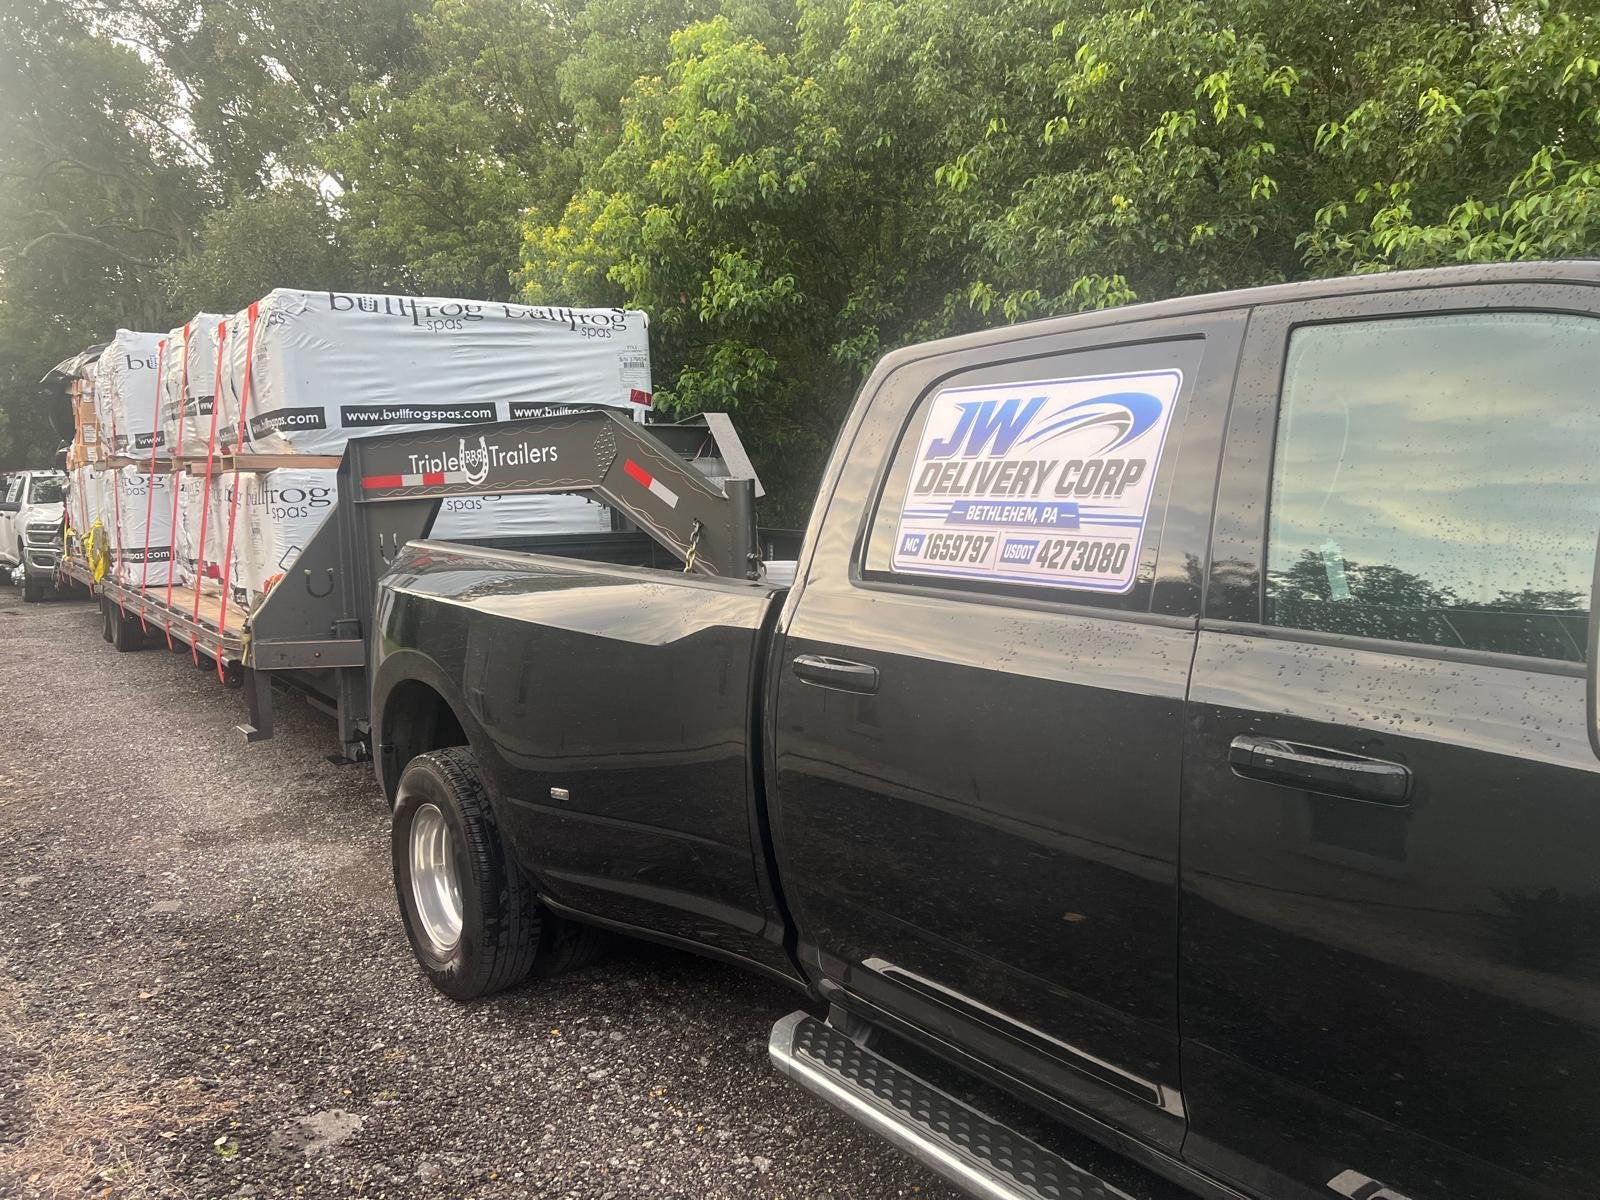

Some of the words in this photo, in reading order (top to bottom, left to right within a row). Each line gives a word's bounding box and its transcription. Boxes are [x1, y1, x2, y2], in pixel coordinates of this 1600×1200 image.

[329, 292, 484, 326] bullfrog
[426, 318, 463, 332] spas
[581, 326, 612, 339] spas
[346, 407, 492, 421] www.bullfrogspas.com
[924, 397, 1049, 460] JW
[409, 453, 459, 475] Triple
[489, 442, 558, 467] Trailers
[914, 459, 1059, 498] DELIVERY
[1054, 458, 1147, 499] CORP
[272, 506, 308, 522] spas
[445, 499, 482, 512] spas
[966, 505, 1038, 525] BETHLEHEM,
[1040, 506, 1059, 523] PA
[904, 537, 918, 552] MC
[923, 533, 995, 563] 1659797
[1004, 543, 1035, 560] USDOT
[1036, 539, 1130, 574] 4273080
